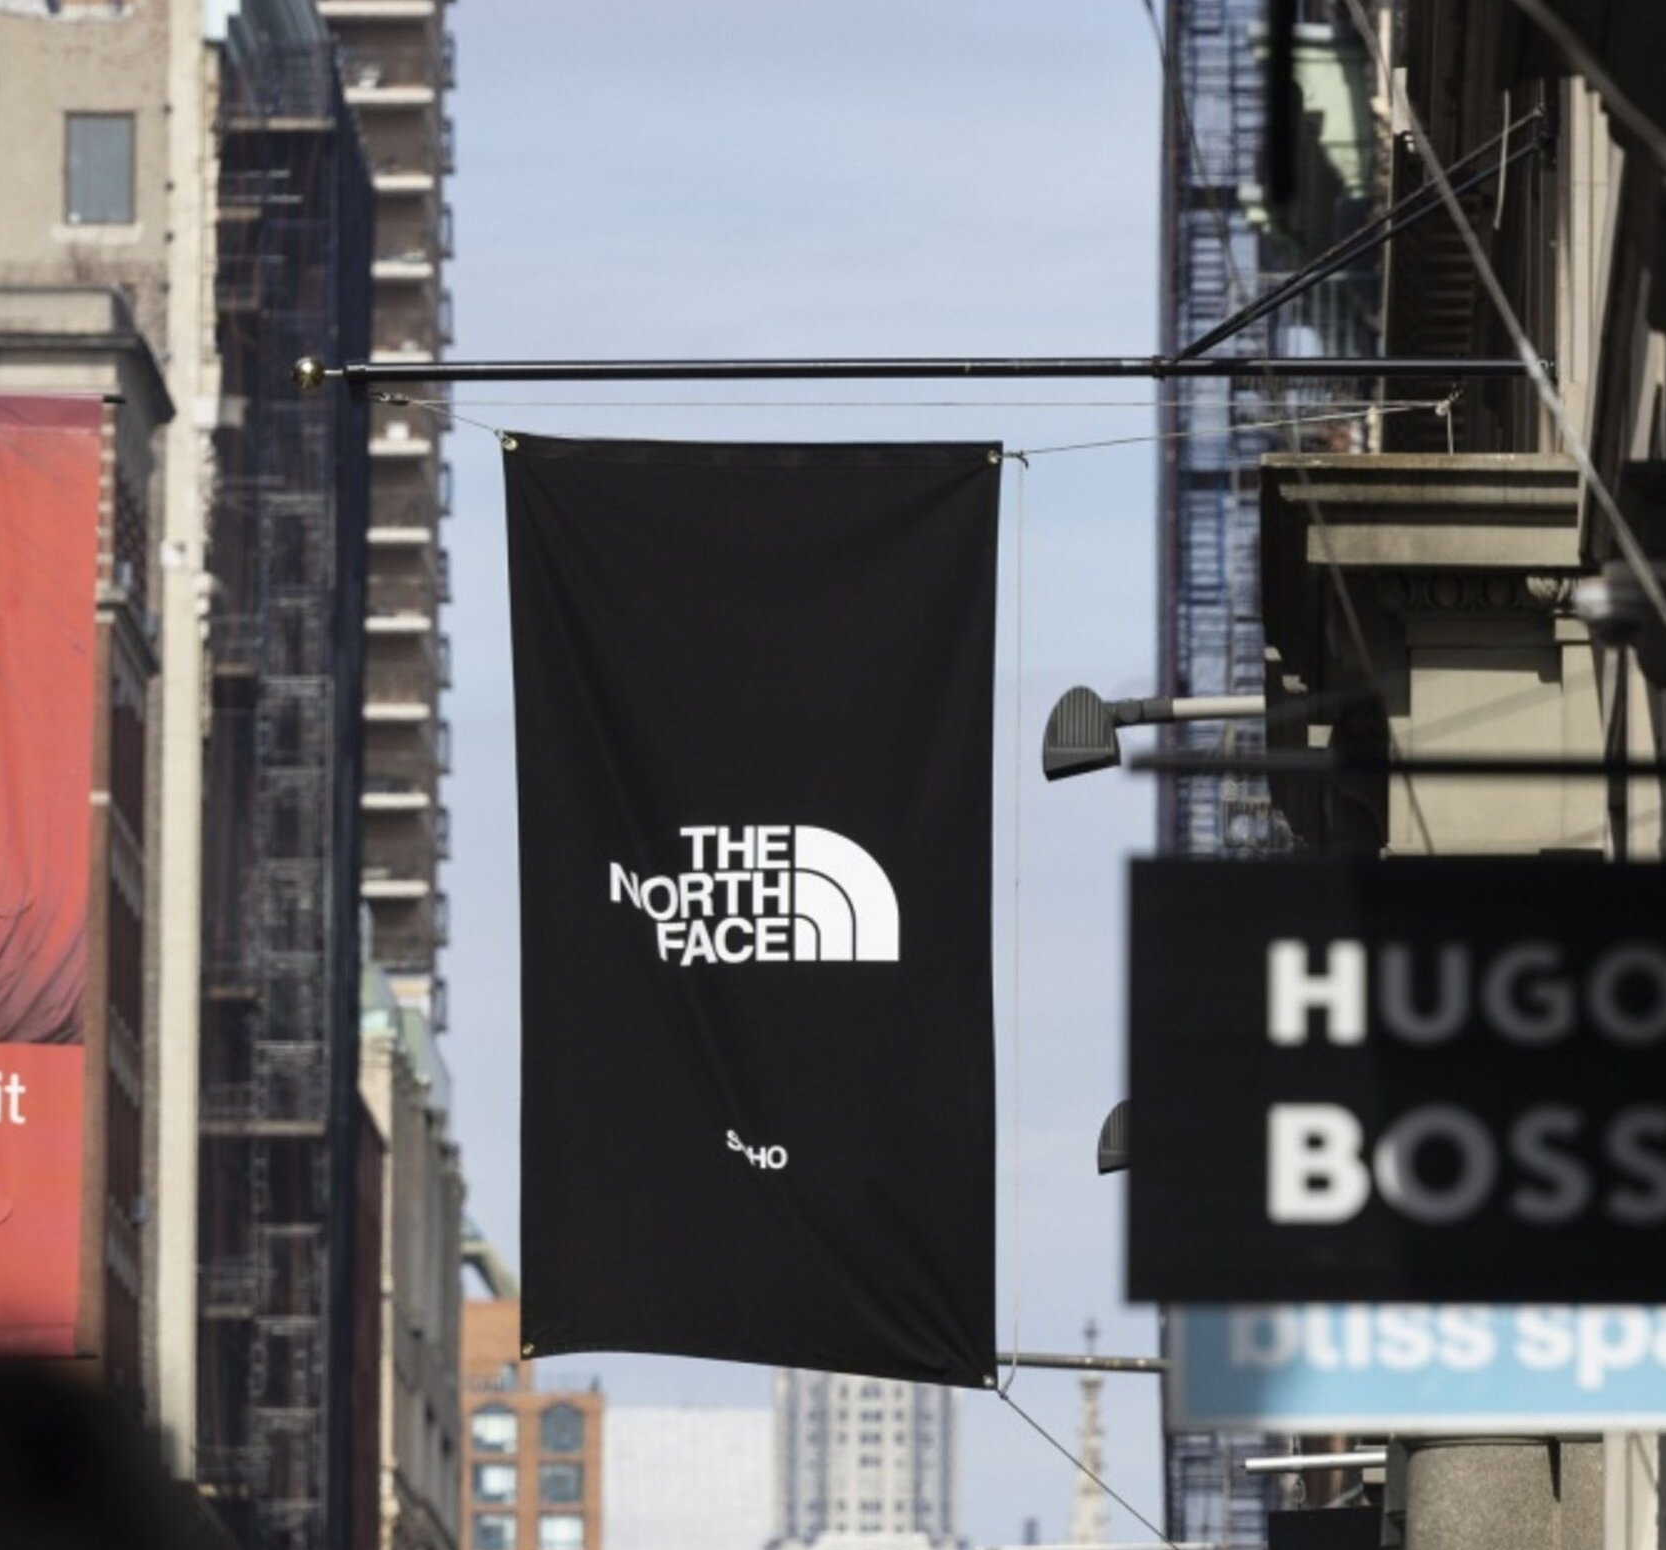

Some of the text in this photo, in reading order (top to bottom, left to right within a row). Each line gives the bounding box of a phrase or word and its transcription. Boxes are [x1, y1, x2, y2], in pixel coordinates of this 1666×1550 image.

[679, 825, 791, 870] THE
[609, 861, 791, 921] NORTH
[655, 916, 791, 967] FACE
[726, 1129, 789, 1170] SHO
